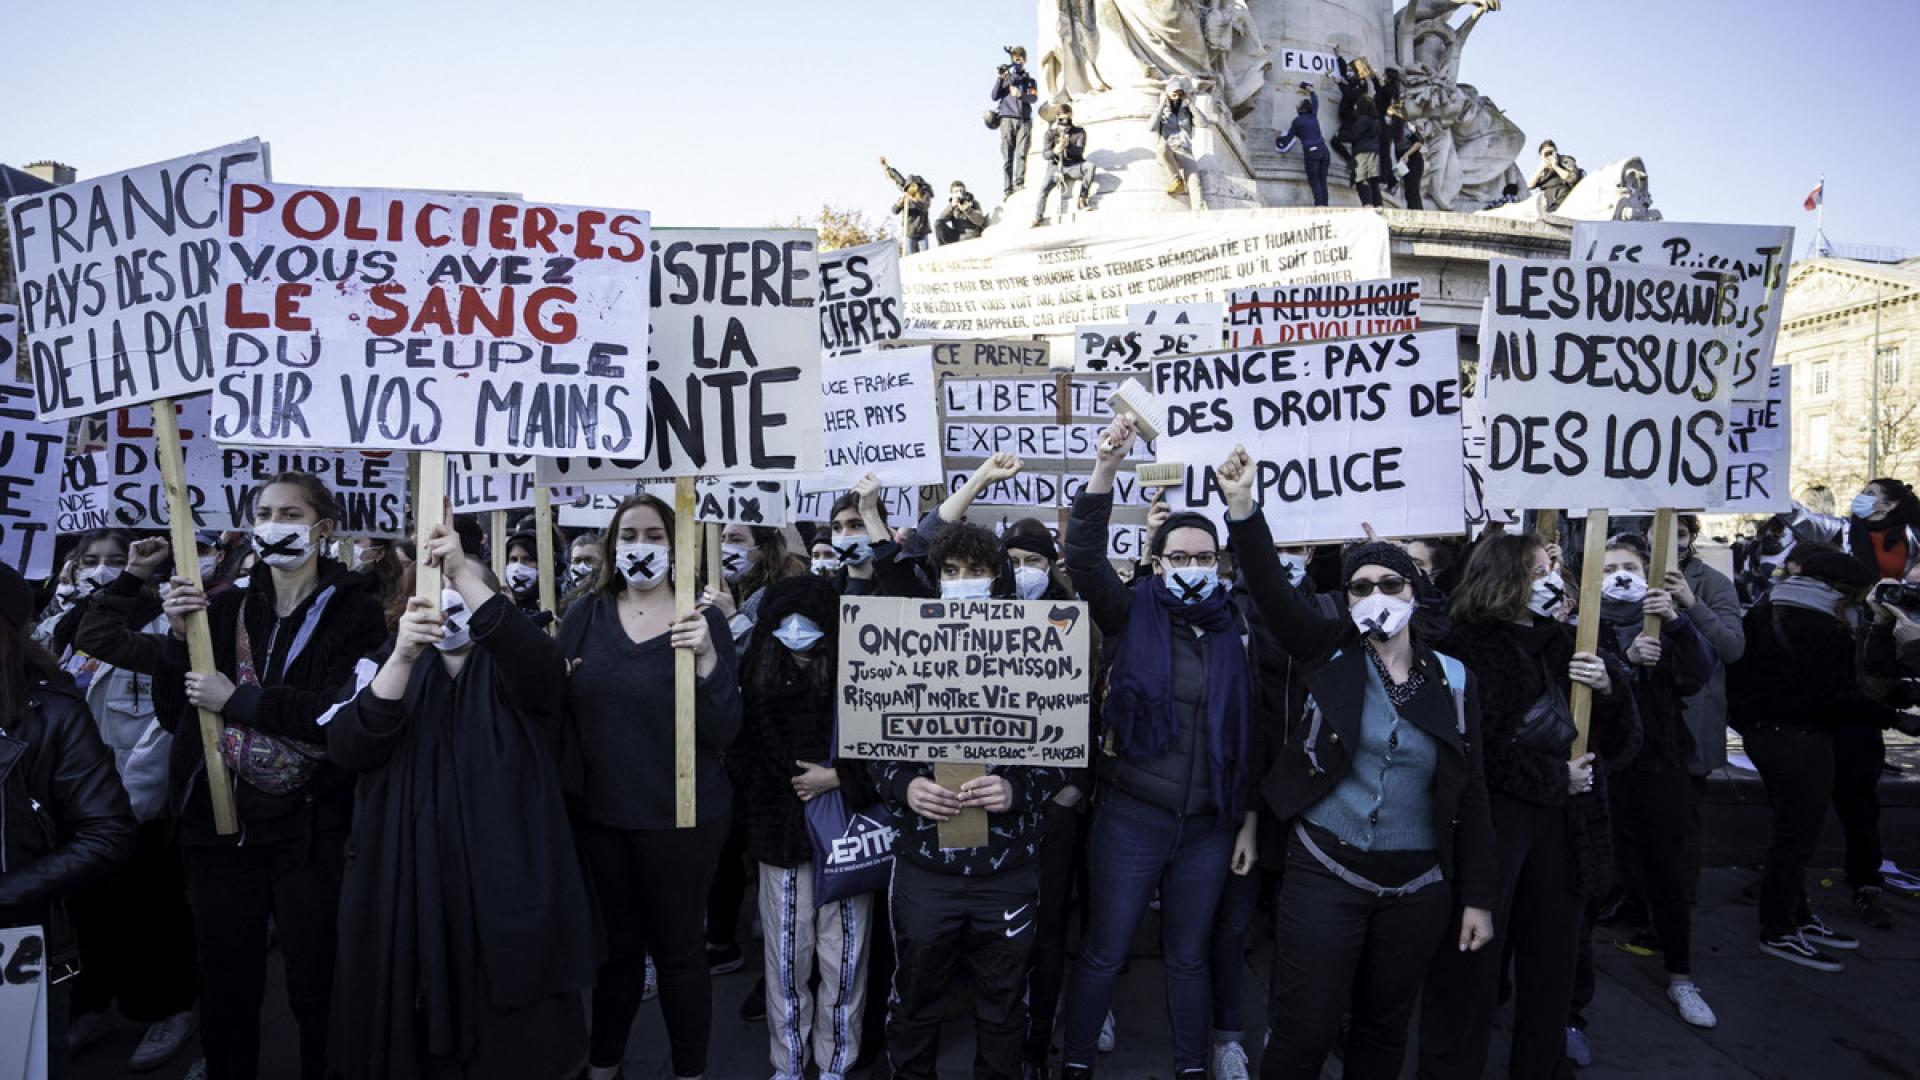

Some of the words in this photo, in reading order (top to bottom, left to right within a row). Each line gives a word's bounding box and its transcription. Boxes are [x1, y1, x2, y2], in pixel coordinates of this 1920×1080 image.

[1284, 51, 1336, 72] FLOU
[228, 242, 398, 285] VOUS
[428, 255, 577, 286] AVEZ
[1079, 265, 1101, 281] LES
[1104, 256, 1155, 277] TERMES
[1243, 236, 1260, 254] ET
[23, 262, 104, 333] PAYS
[114, 244, 176, 309] DES
[1100, 283, 1124, 299] EST
[1127, 279, 1145, 295] DE
[1231, 290, 1264, 326] LA
[1273, 281, 1420, 322] REPUBLIQUE
[1494, 264, 1581, 320] LES
[1586, 264, 1740, 328] PUISSANTS
[224, 283, 314, 330] LE
[367, 283, 578, 344] SANG
[1032, 310, 1055, 327] CAR
[226, 332, 322, 368] DU
[365, 337, 629, 378] PEUPLE
[692, 315, 759, 370] LA
[974, 342, 1050, 368] PRENEZ
[1080, 330, 1143, 365] PAS
[1323, 333, 1420, 381] PAYS
[31, 335, 84, 414] DE
[87, 318, 138, 405] LA
[1489, 329, 1539, 383] AU
[1549, 333, 1729, 402] DESSUS
[214, 370, 313, 439] SUR
[340, 373, 443, 445] VOS
[475, 380, 634, 453] MAINS
[824, 409, 860, 433] HER
[864, 403, 907, 428] PAYS
[1166, 397, 1234, 438] DES
[1253, 381, 1398, 431] DROITS
[1410, 379, 1461, 418] DE
[1488, 410, 1590, 478] DES
[1604, 410, 1725, 487] LOIS
[1185, 465, 1228, 508] LA
[1257, 447, 1405, 507] POLICE
[949, 602, 1025, 622] PLAYZEN
[913, 659, 959, 680] LEUR
[927, 687, 980, 710] NOTRE
[927, 745, 949, 758] DE
